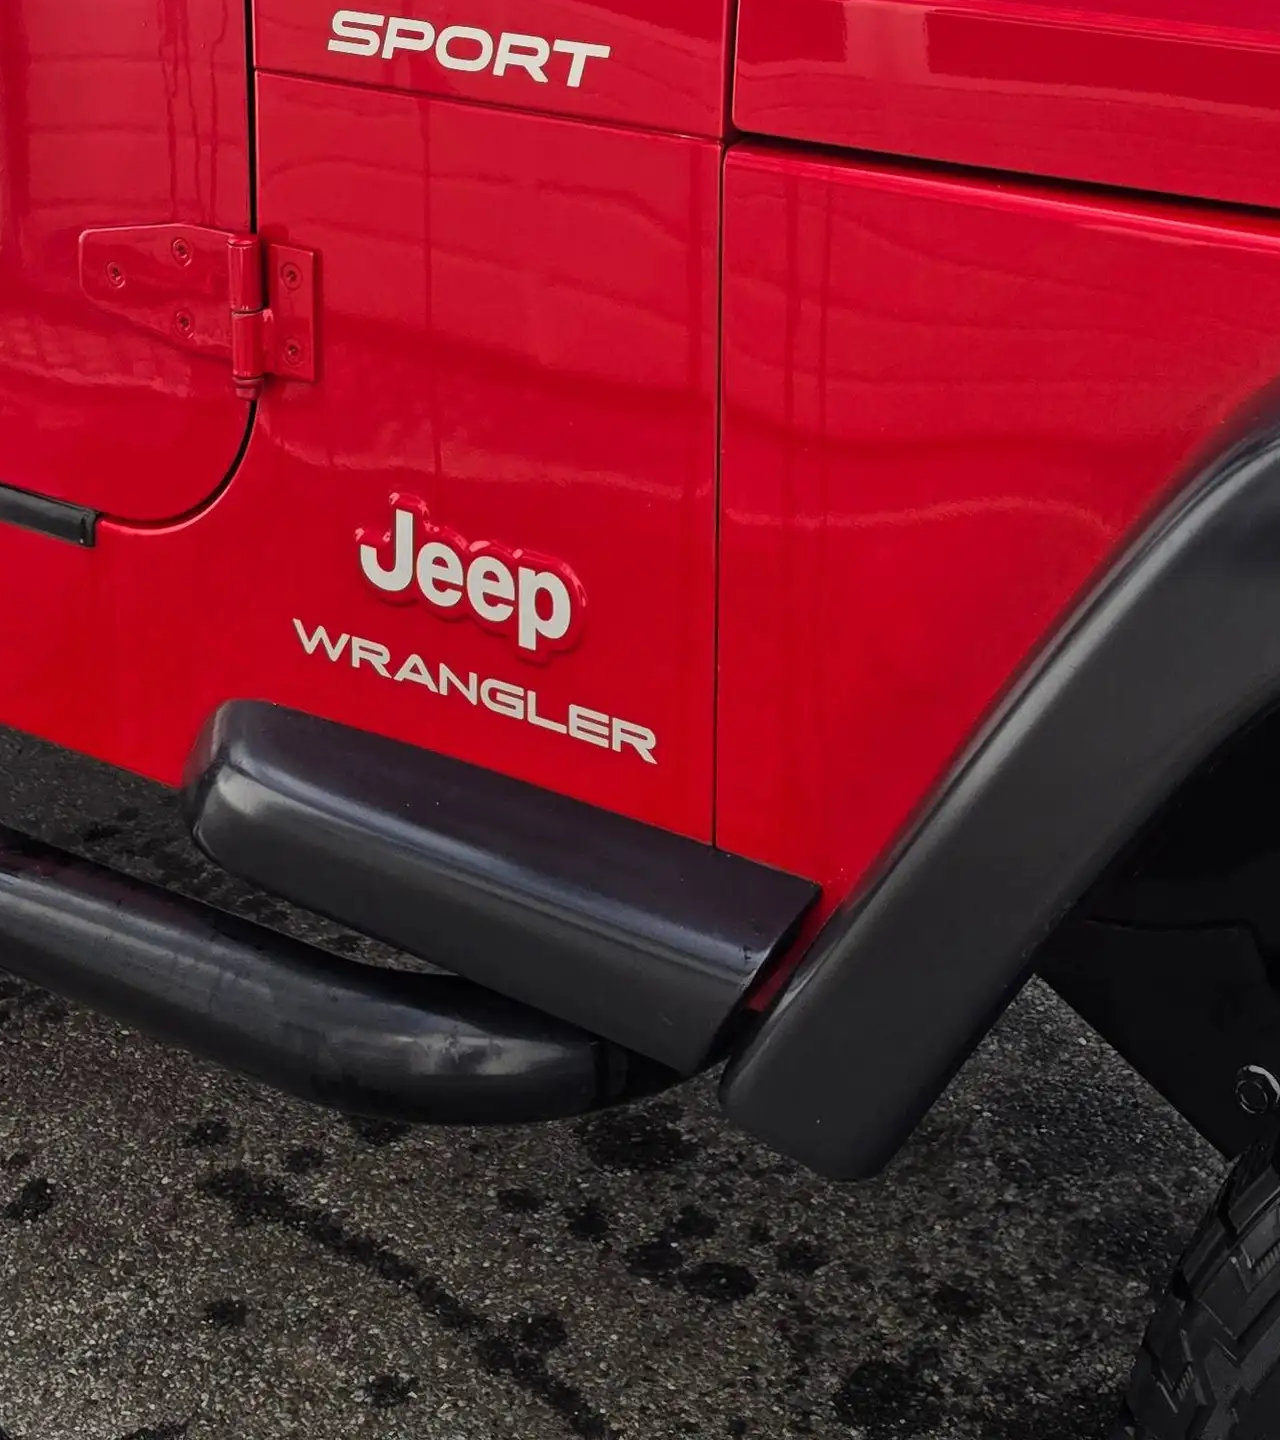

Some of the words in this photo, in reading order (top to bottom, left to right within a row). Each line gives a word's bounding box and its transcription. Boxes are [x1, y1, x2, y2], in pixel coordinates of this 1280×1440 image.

[327, 9, 611, 88] SPORT
[357, 508, 572, 652] Jeep
[291, 616, 659, 765] WRANGLER
